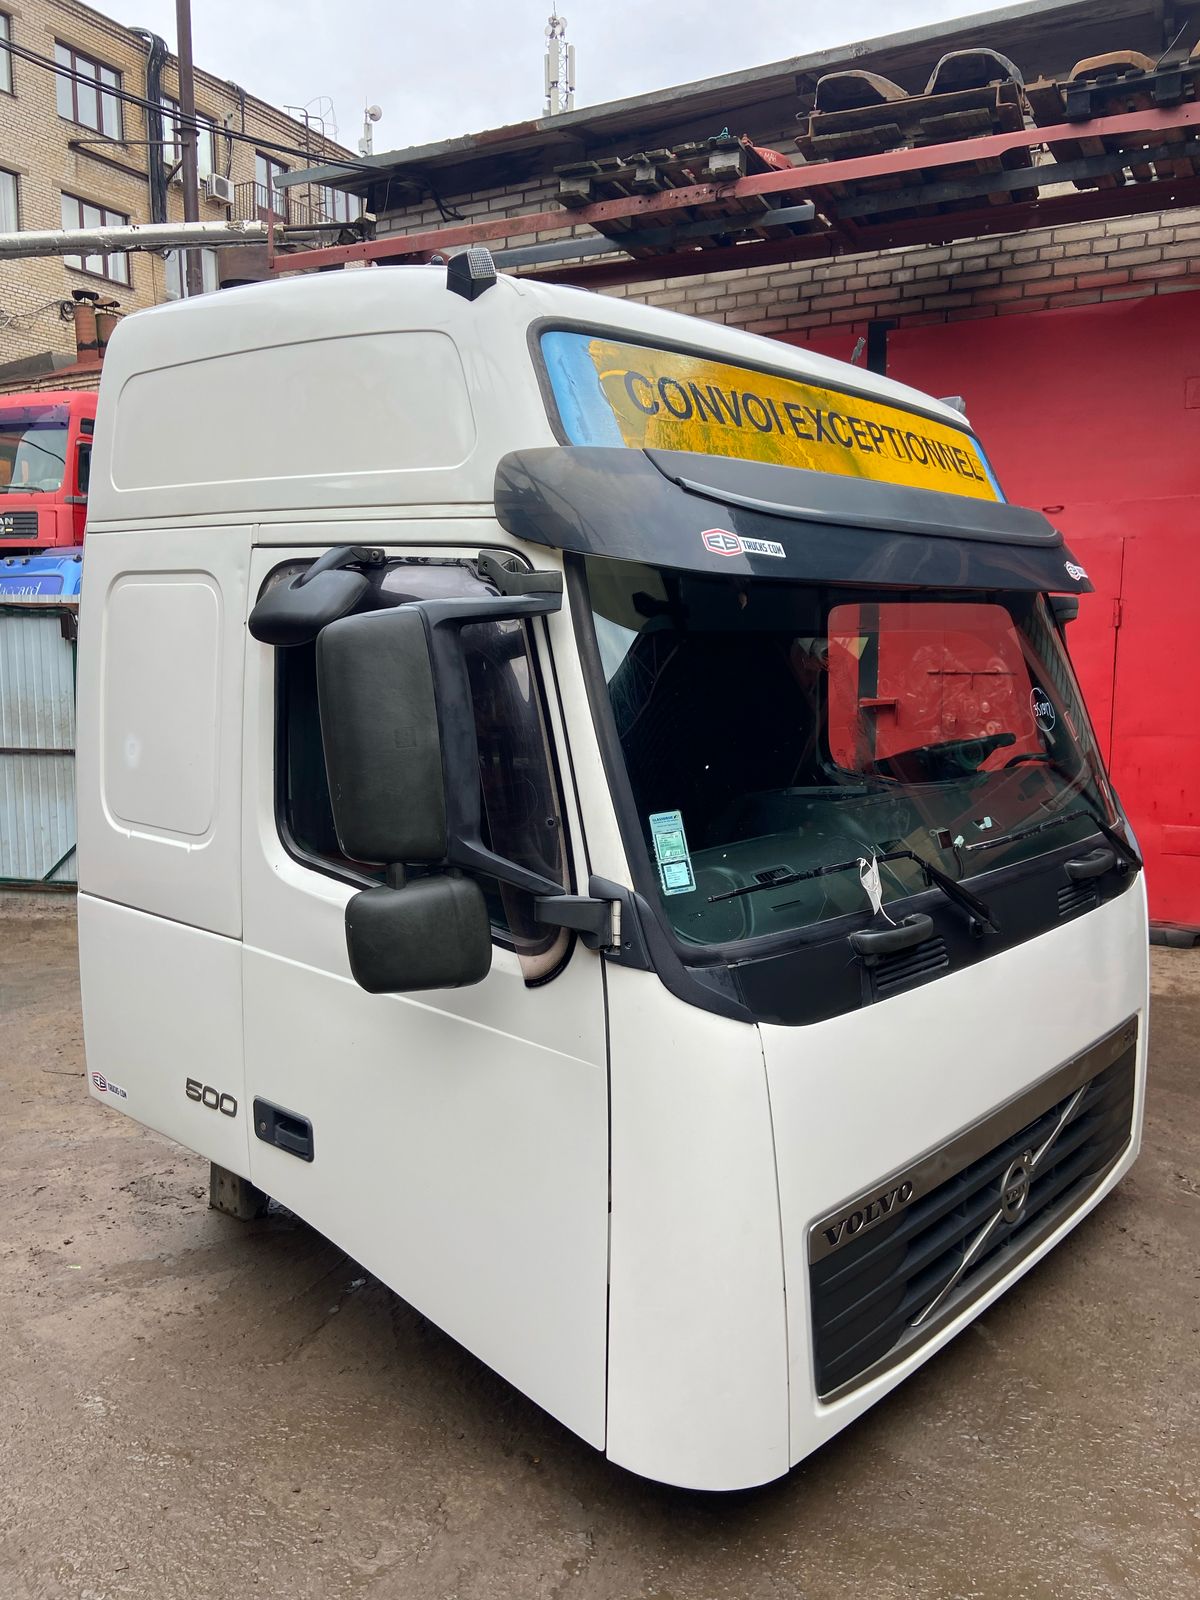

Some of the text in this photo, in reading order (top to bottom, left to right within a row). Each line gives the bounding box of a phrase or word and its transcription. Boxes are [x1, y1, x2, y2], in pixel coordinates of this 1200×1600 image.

[623, 370, 985, 482] CONVOI EXCEPTIONNEL
[741, 539, 769, 553] TRUCKS
[185, 1077, 238, 1118] 500
[822, 1180, 913, 1247] VOLVO
